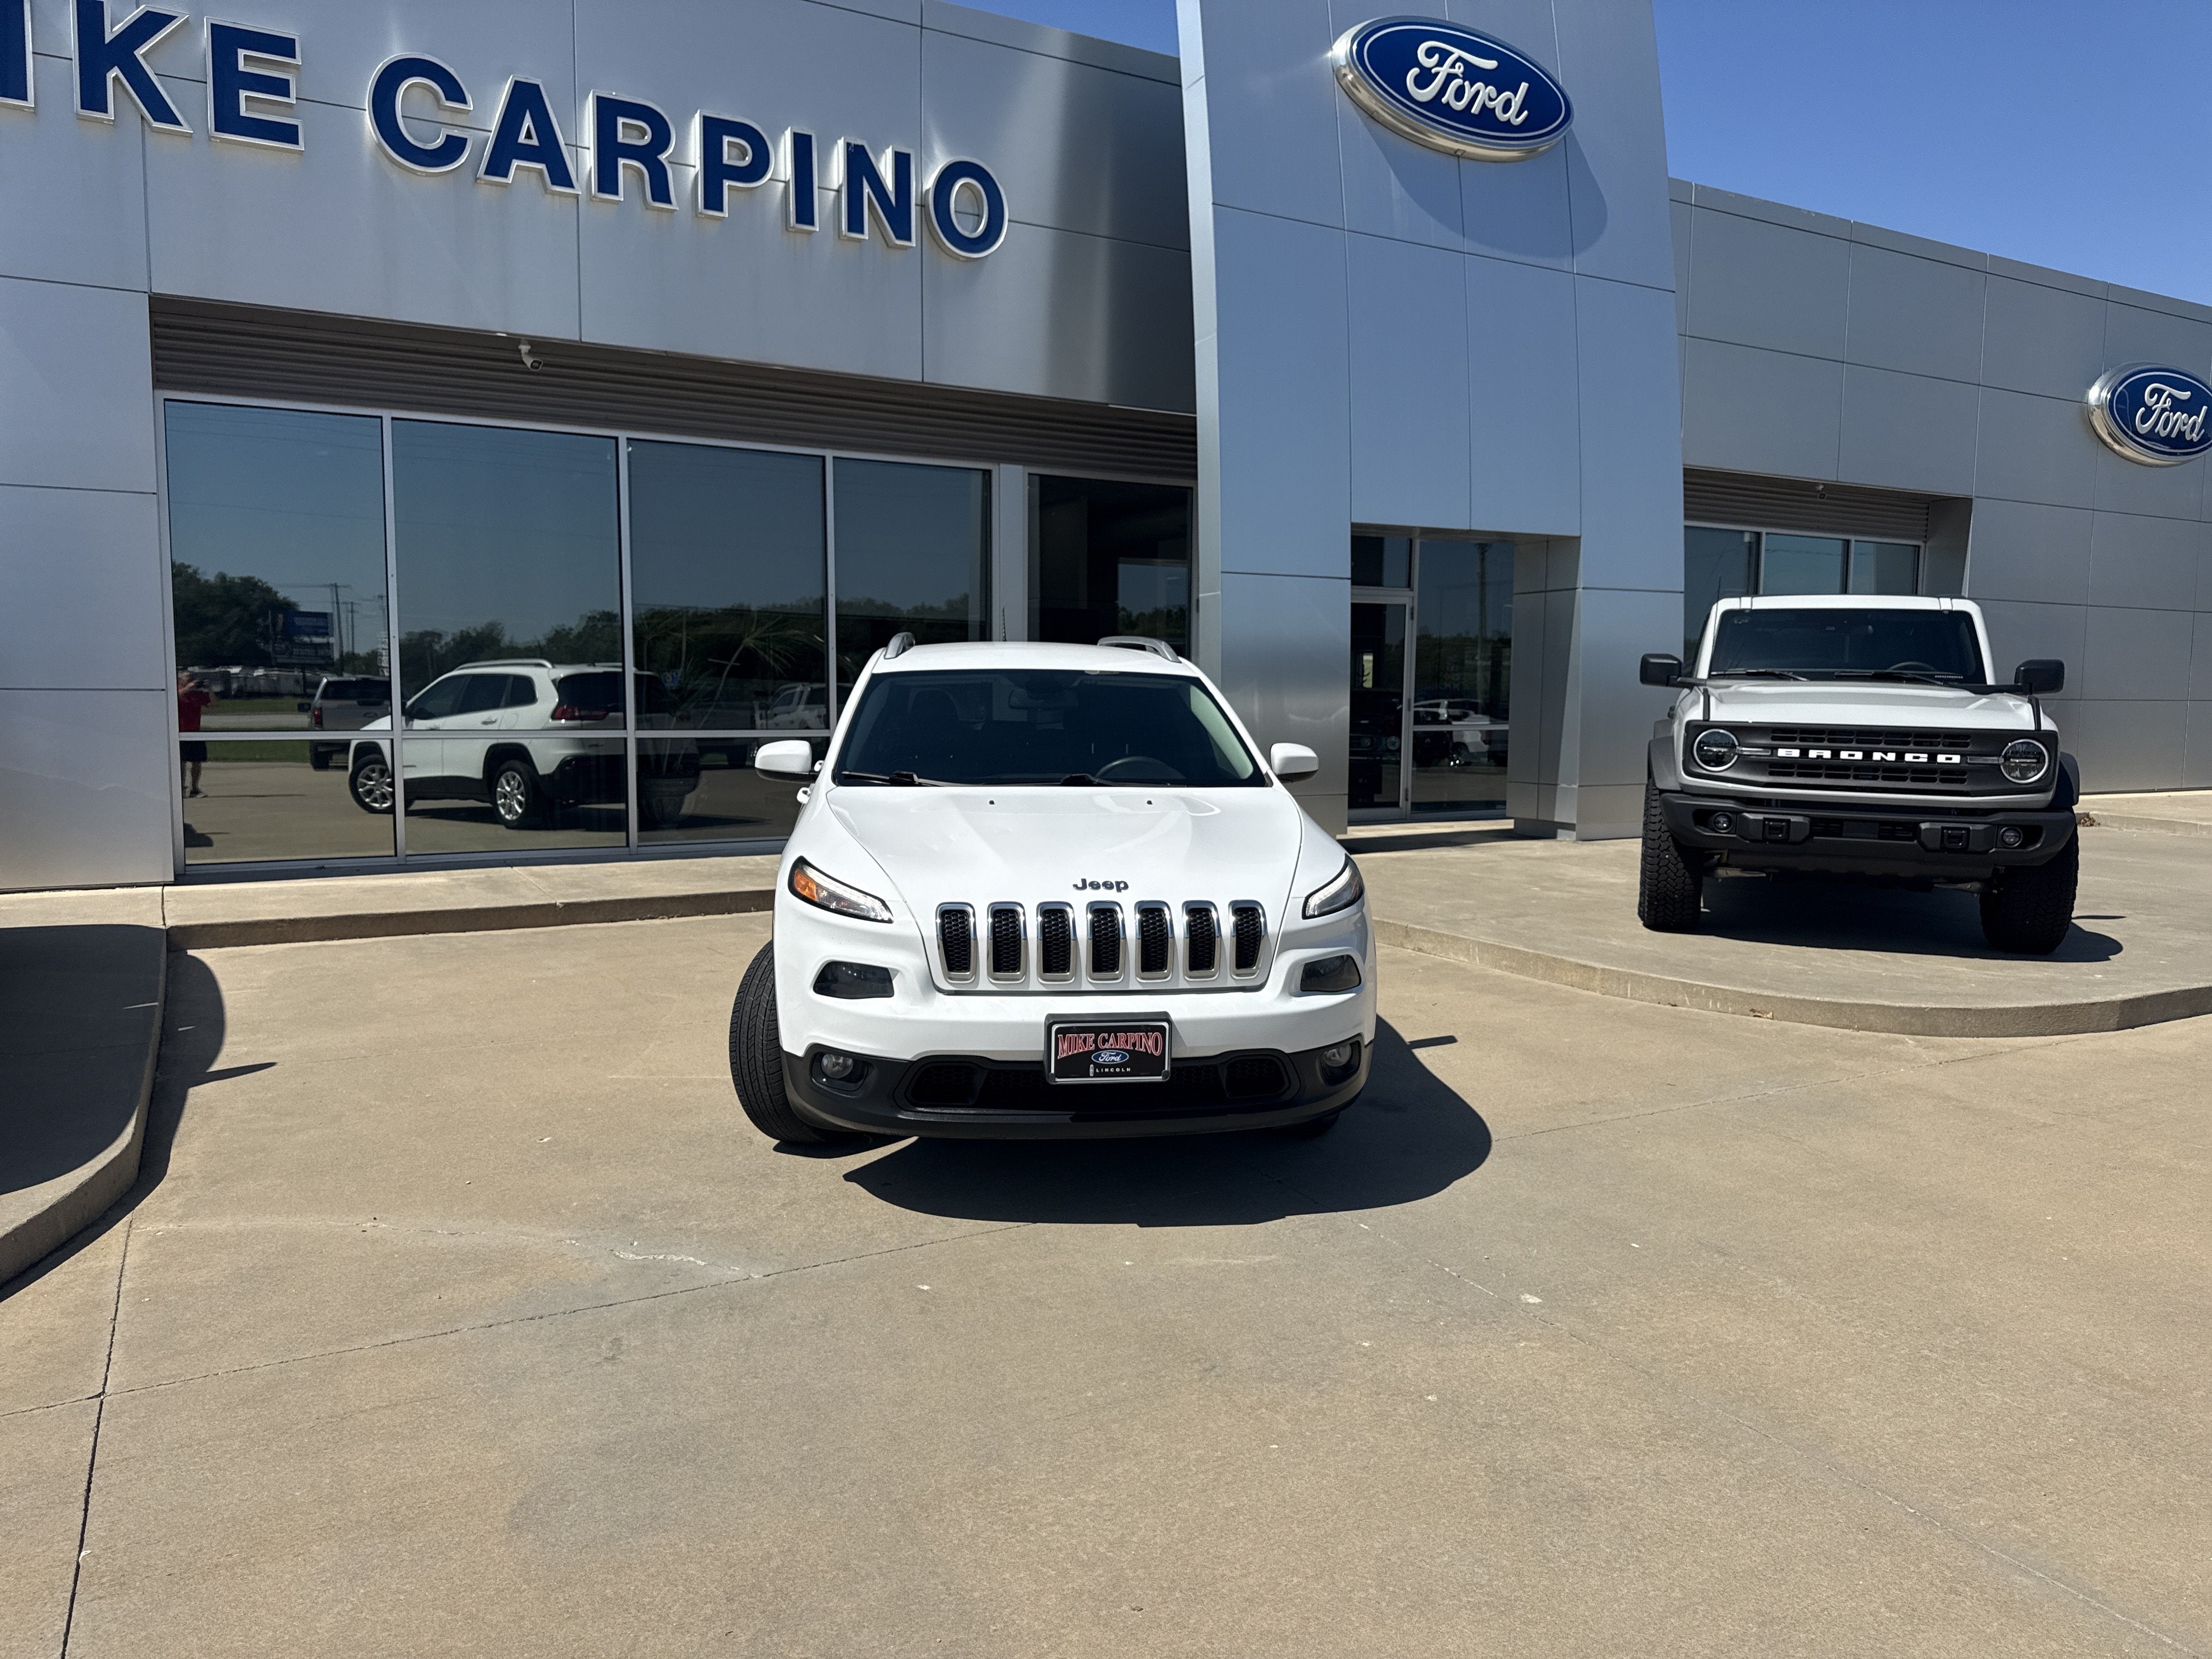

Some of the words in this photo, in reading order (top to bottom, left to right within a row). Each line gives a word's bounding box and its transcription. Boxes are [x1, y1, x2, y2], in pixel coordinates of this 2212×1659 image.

[1406, 41, 1530, 126] Ford
[366, 52, 1009, 261] CARPINO
[2135, 382, 2208, 443] Ford
[1778, 748, 1961, 764] BRONCO
[1073, 878, 1129, 893] Jeep
[1057, 1033, 1095, 1059] MIKE
[1098, 1032, 1163, 1056] CARPINO
[1098, 1052, 1122, 1062] Ford
